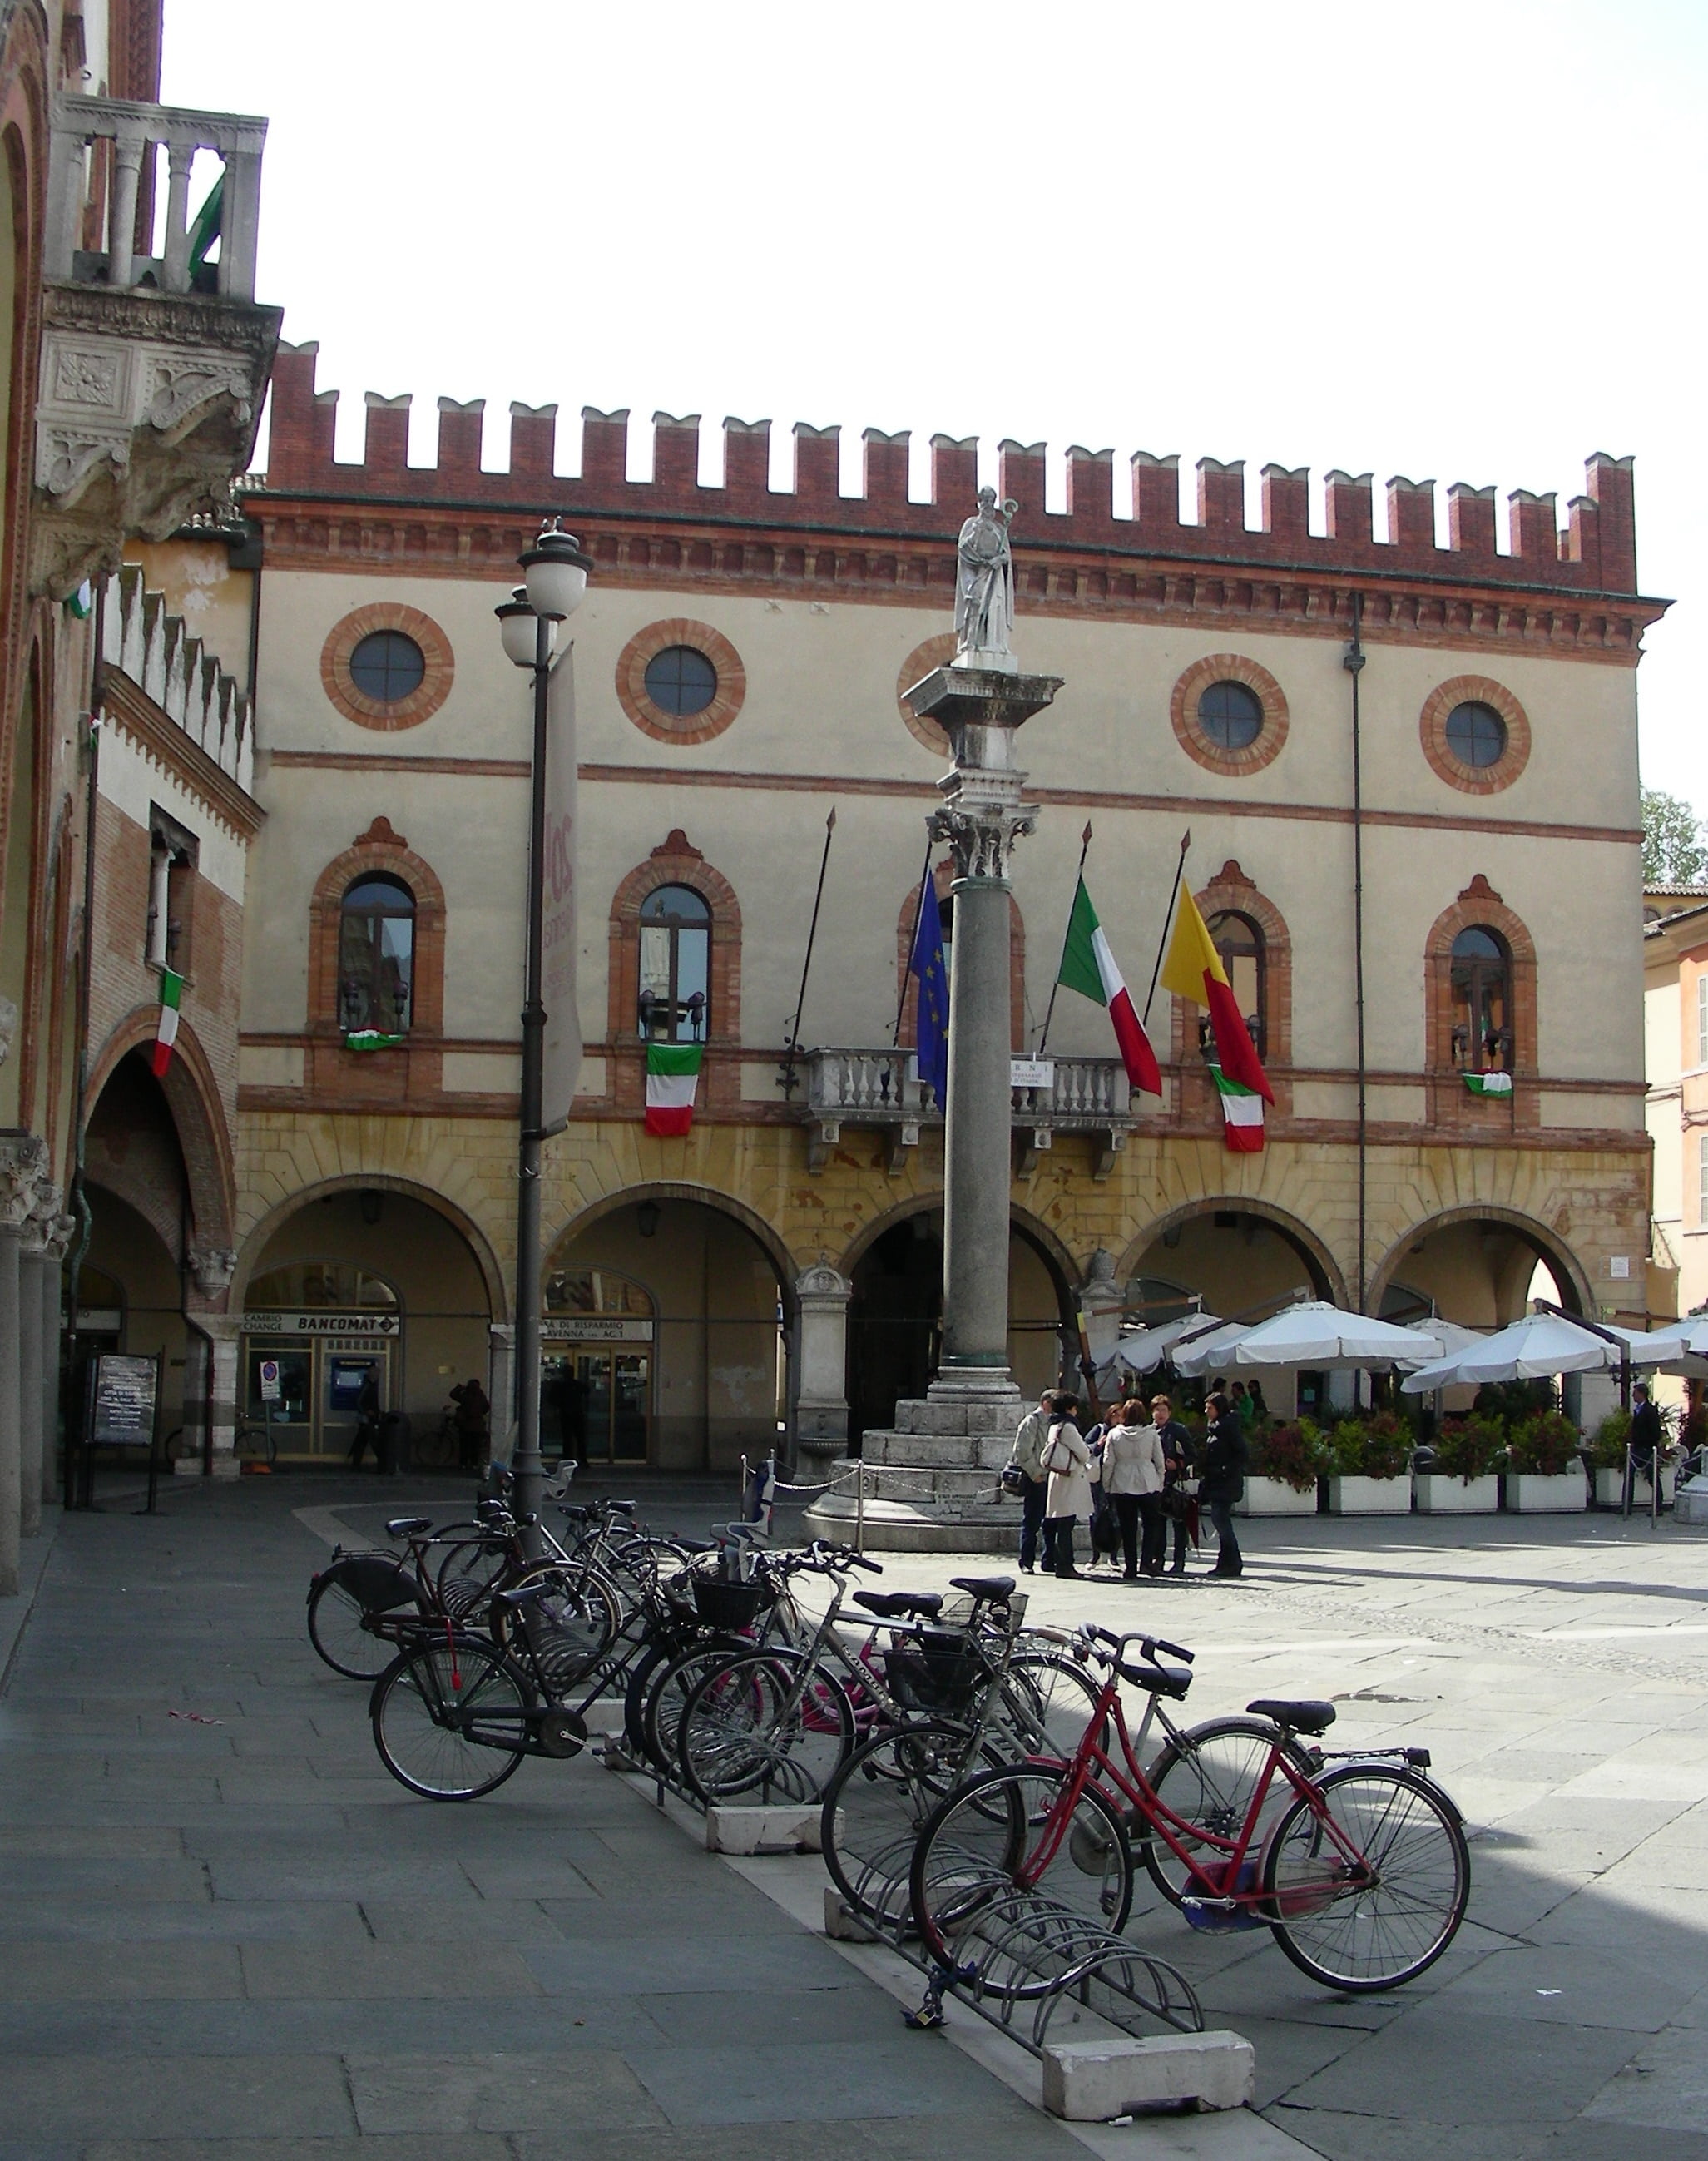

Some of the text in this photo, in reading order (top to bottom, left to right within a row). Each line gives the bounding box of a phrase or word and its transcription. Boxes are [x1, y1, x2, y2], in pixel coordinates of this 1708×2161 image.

[244, 1313, 282, 1322] CAMBIO
[243, 1322, 283, 1331] CHANGE
[298, 1317, 377, 1331] BANCOMAT
[559, 1321, 570, 1329] DI
[574, 1321, 623, 1330] RISPARMIO
